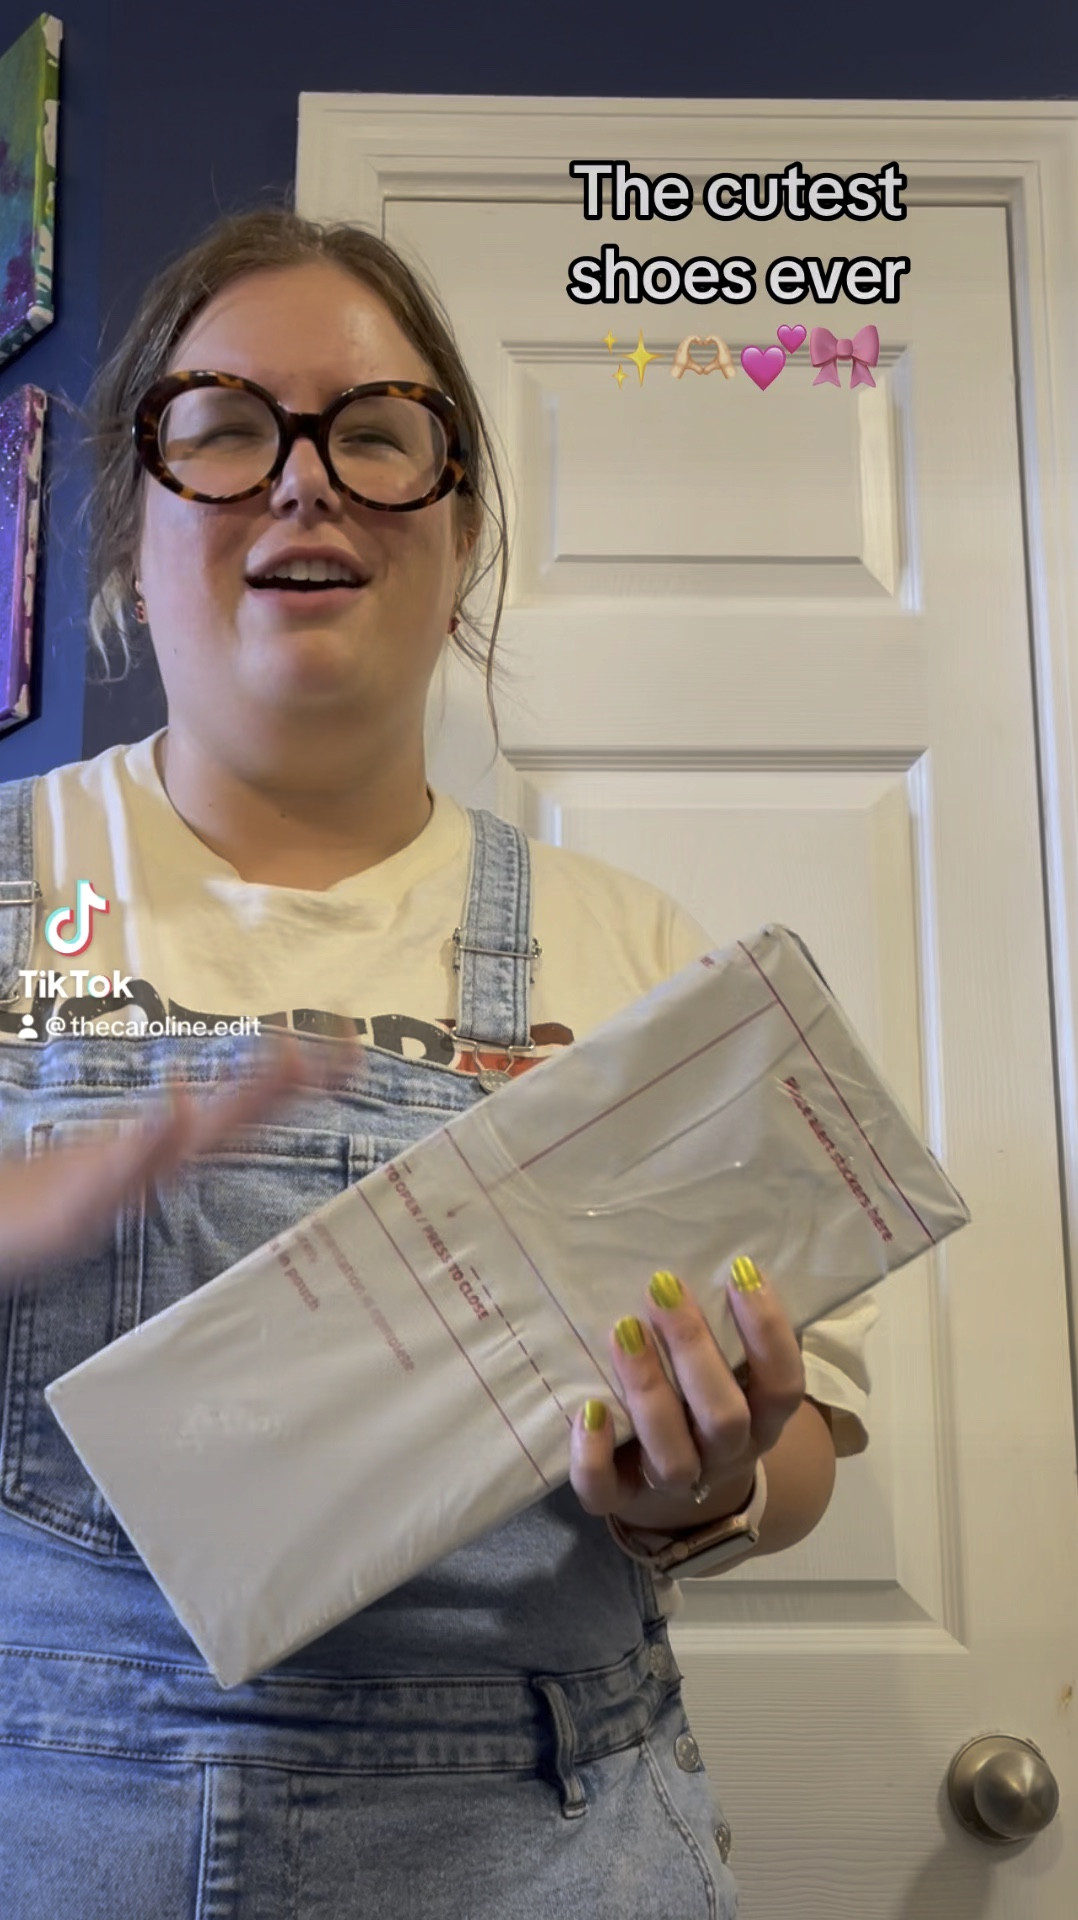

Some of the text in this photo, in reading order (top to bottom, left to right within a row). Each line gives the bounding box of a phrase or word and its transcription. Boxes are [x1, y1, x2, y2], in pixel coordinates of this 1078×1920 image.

[395, 1181, 422, 1216] OPEN
[422, 1224, 452, 1263] PRESS
[448, 1262, 465, 1282] TO
[459, 1280, 489, 1321] CLOSE
[830, 1152, 872, 1208] stickers
[867, 1206, 893, 1242] here
